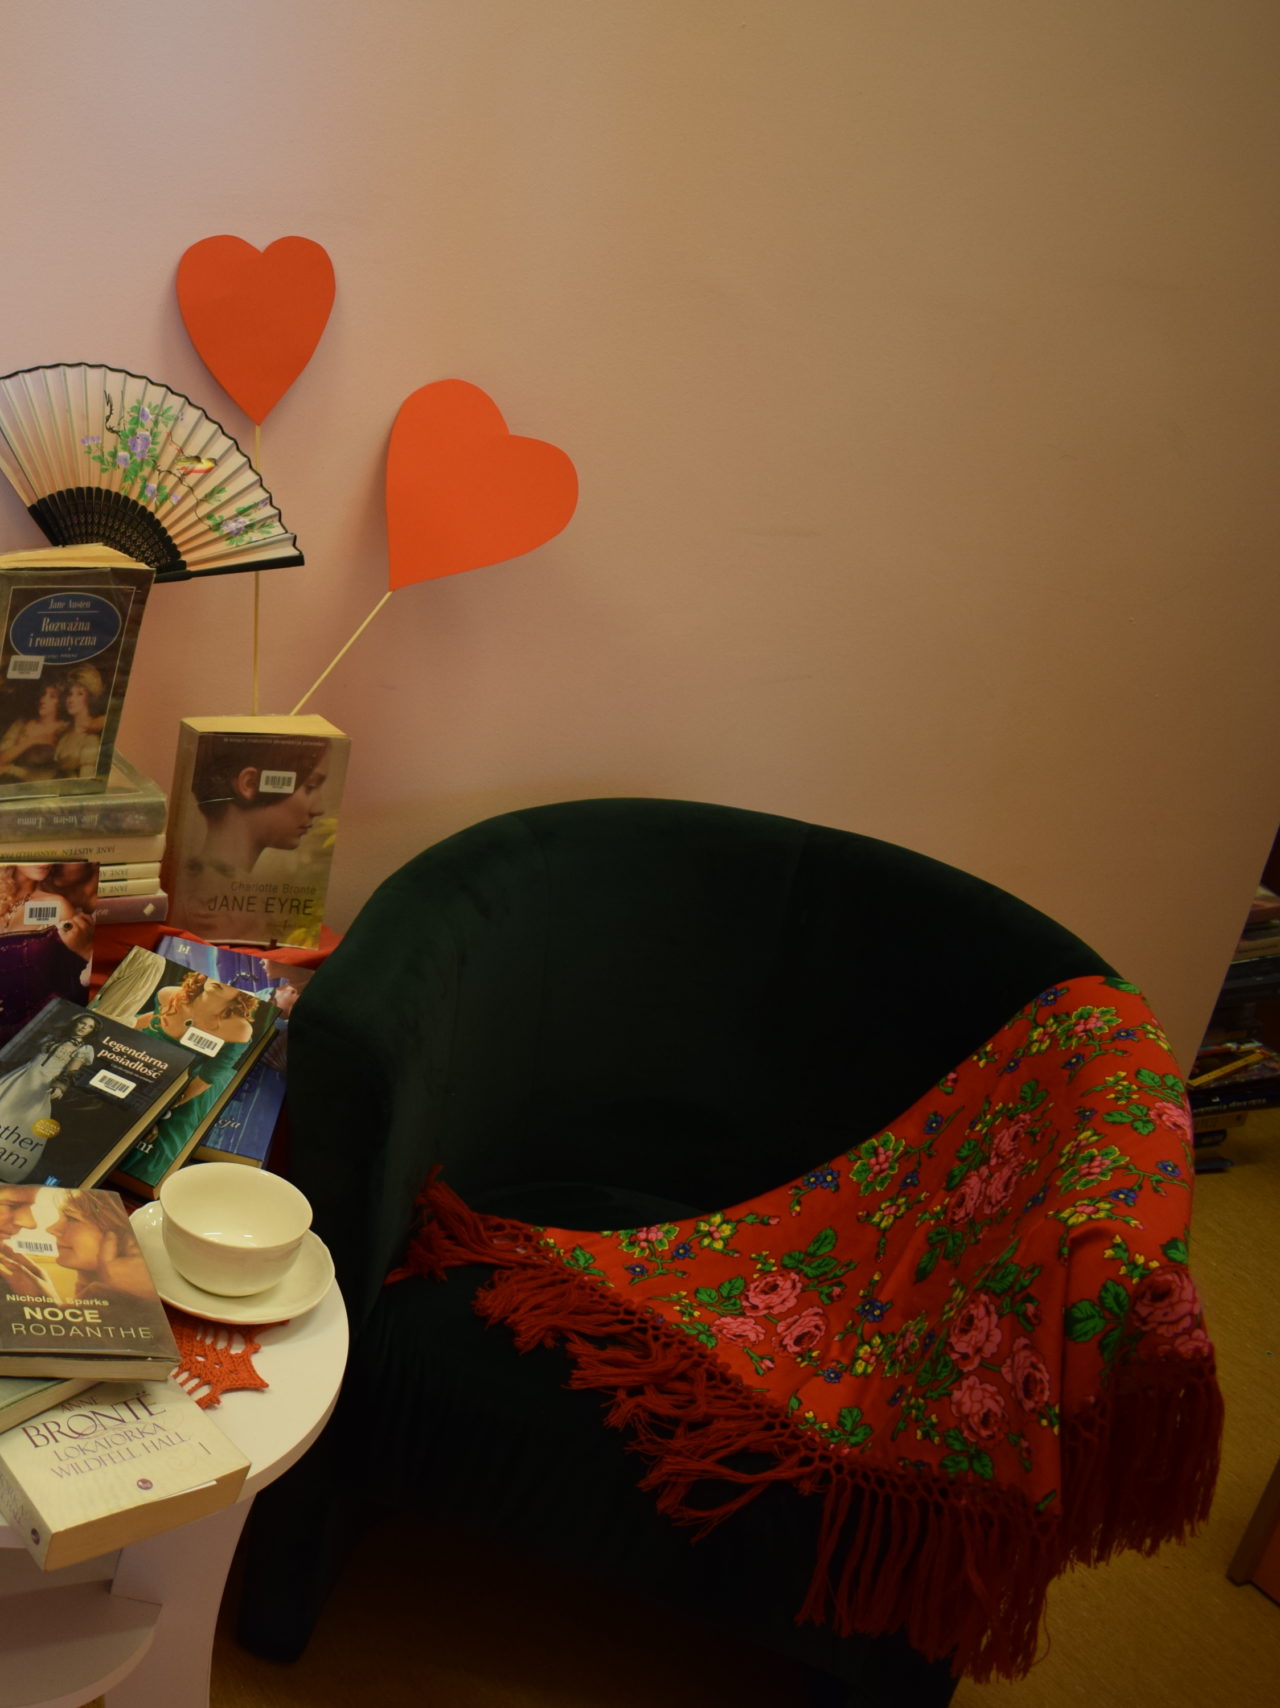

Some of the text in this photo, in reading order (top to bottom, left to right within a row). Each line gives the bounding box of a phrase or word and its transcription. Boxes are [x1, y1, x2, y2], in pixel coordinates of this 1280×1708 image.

[41, 616, 91, 632] Rozważna
[28, 633, 97, 649] i romantyczna
[230, 881, 278, 895] Charlotte
[208, 895, 314, 916] JANE EYRE
[102, 1036, 169, 1070] Legendarna
[97, 1049, 164, 1079] posiadłość
[65, 1296, 110, 1307] Sparks
[23, 1306, 102, 1323] NOCE
[10, 1323, 154, 1339] RODANTHE
[22, 1391, 177, 1449] BRONTË
[53, 1422, 168, 1463] LOKATORKA
[49, 1431, 192, 1479] WILDFELL HALL
